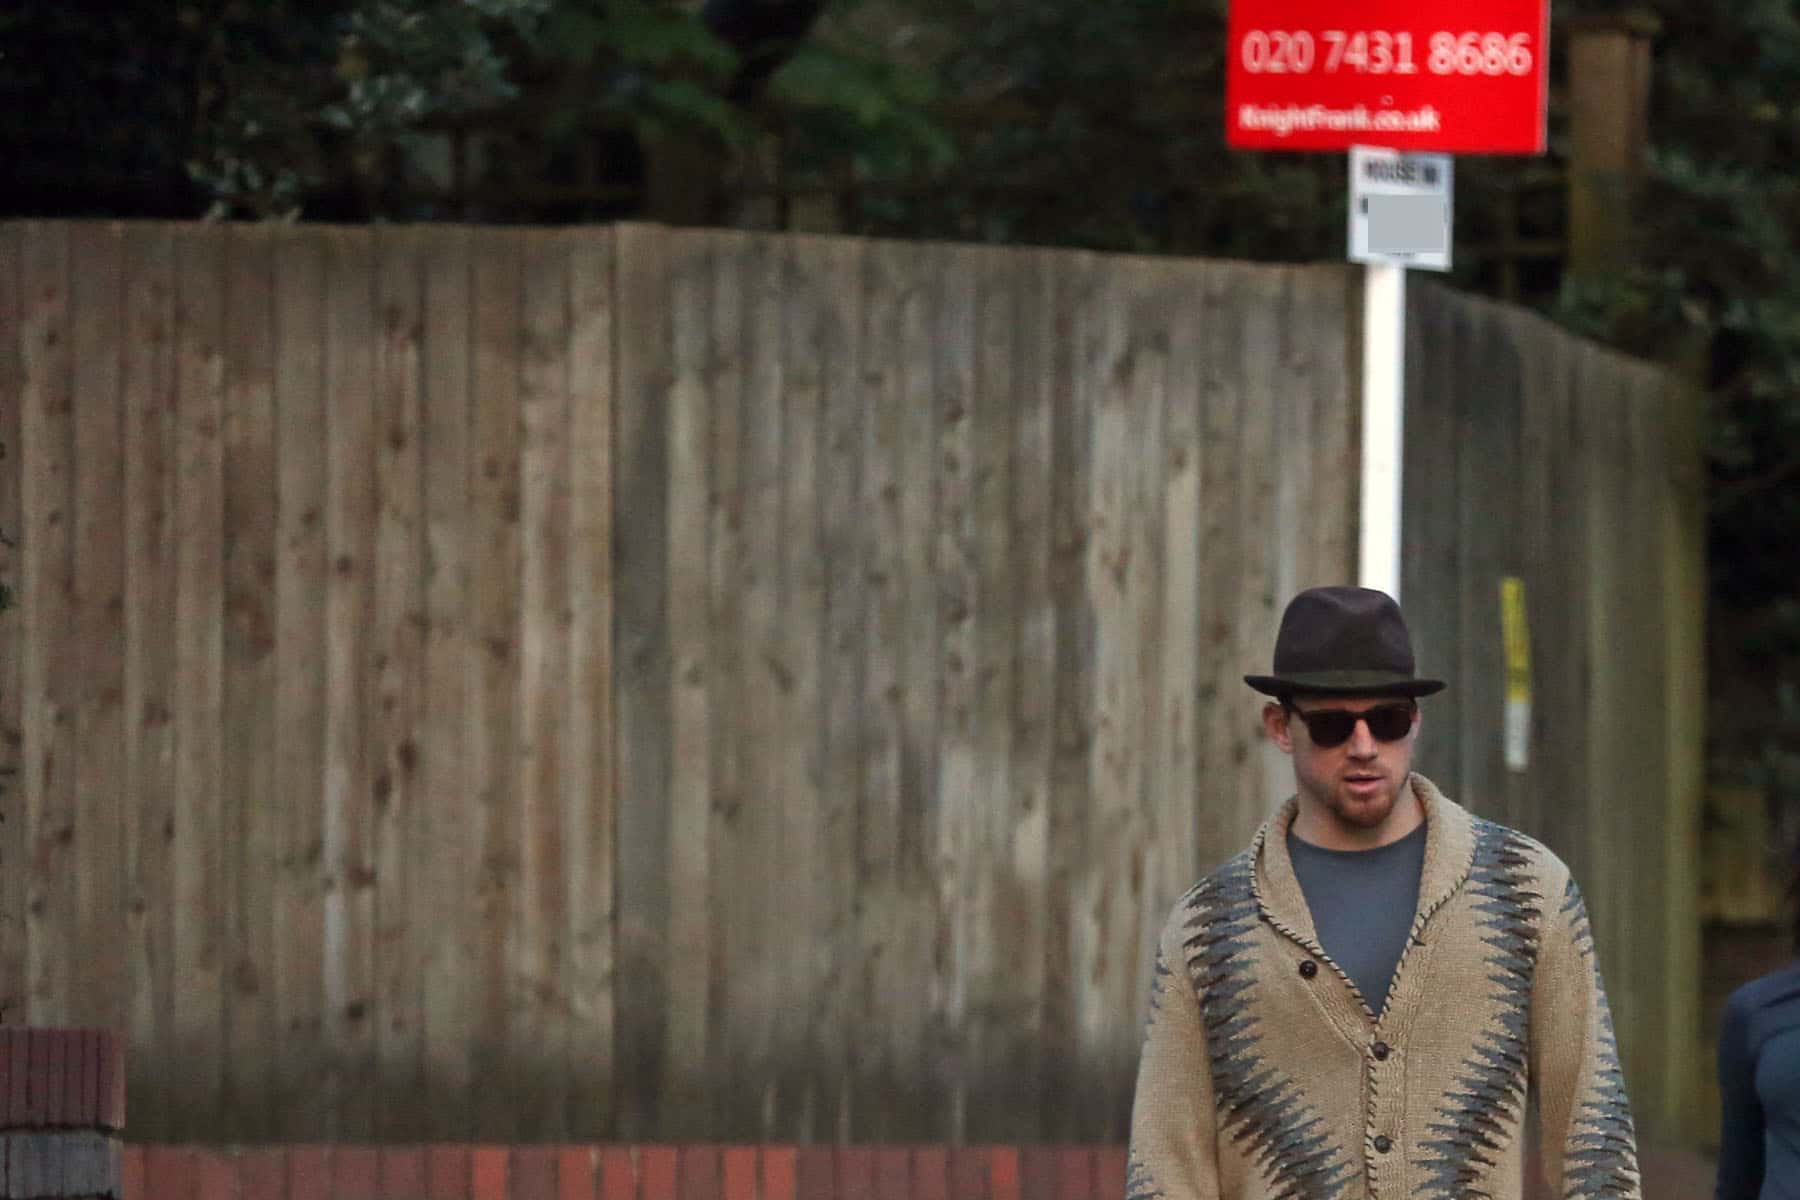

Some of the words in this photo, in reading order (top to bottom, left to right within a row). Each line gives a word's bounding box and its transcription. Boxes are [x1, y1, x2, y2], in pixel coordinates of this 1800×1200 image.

[1241, 30, 1315, 75] 020
[1321, 30, 1417, 75] 7431
[1427, 32, 1533, 77] 8686
